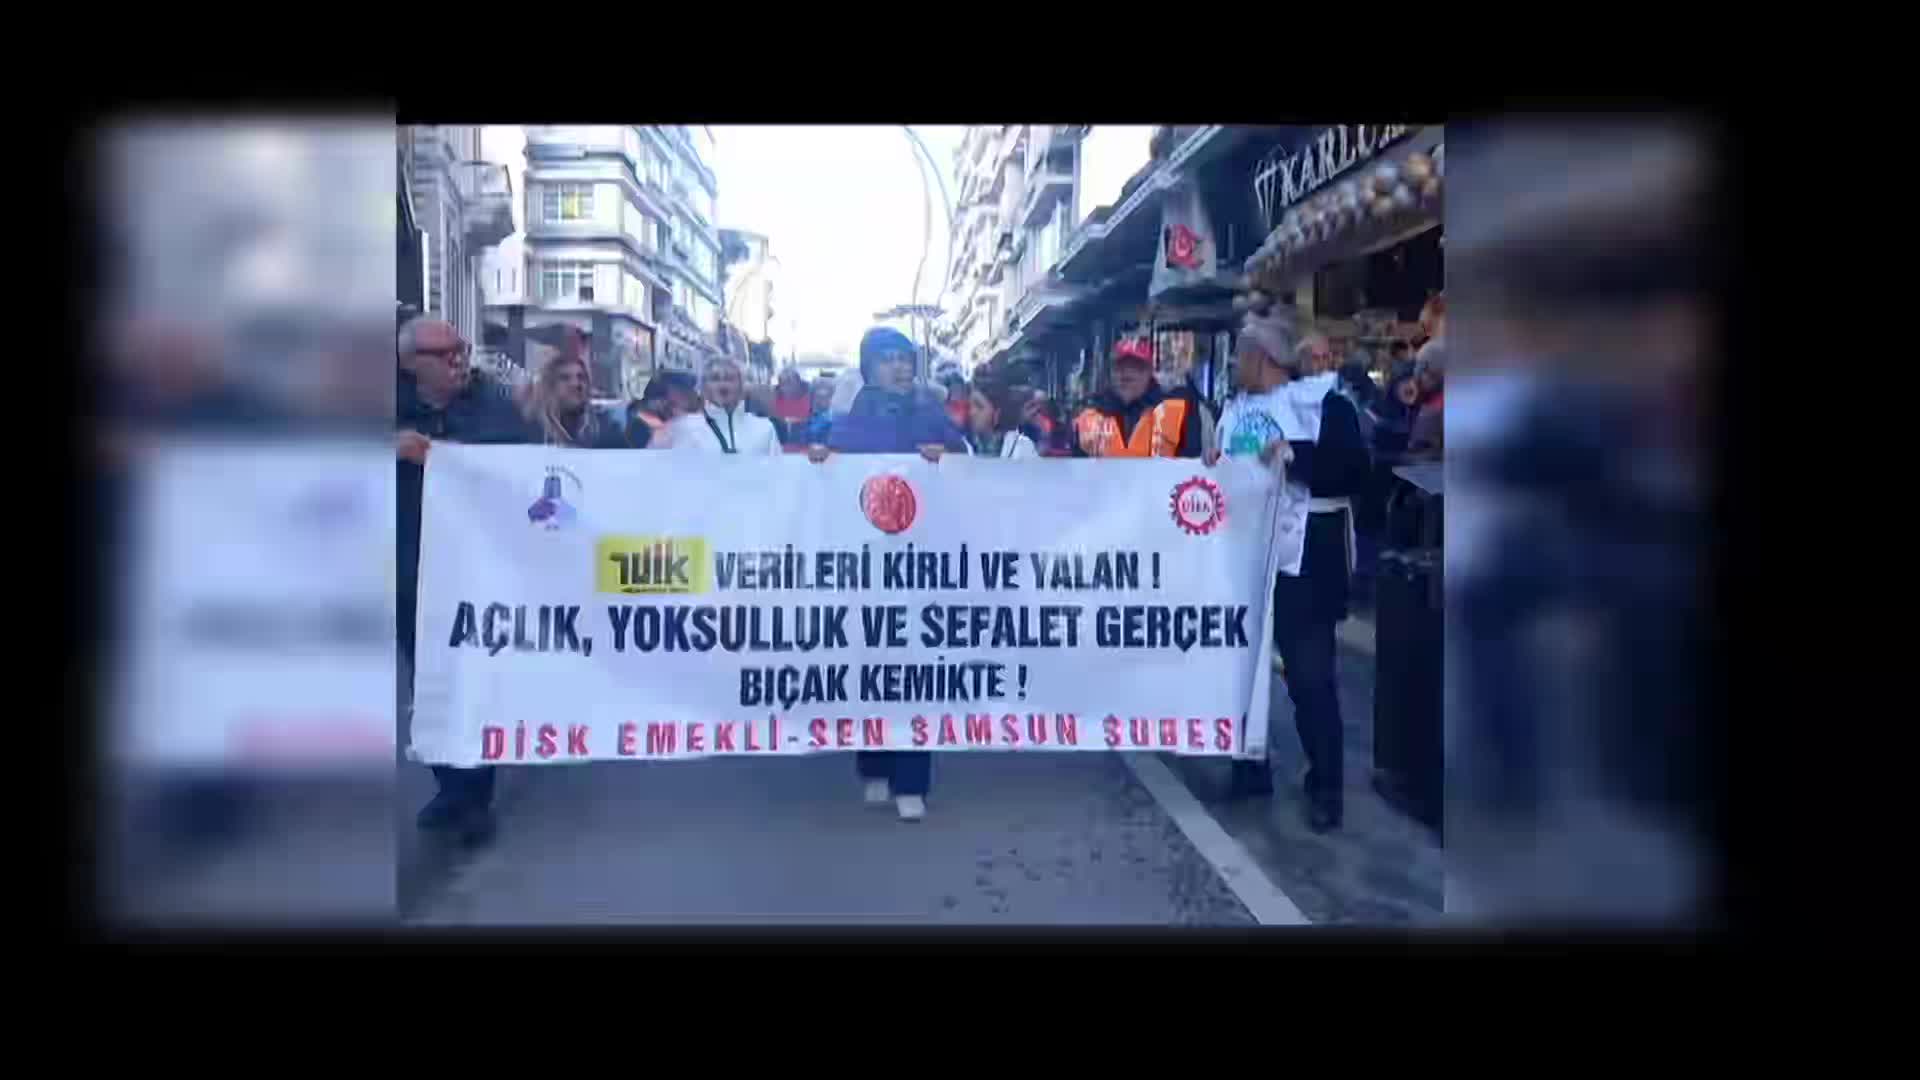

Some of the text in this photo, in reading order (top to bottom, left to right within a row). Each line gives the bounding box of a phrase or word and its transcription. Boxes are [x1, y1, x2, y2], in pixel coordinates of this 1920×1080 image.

[716, 543, 872, 590] VERİLERİ
[883, 542, 969, 590] KİRLİ
[980, 551, 1020, 590] VE
[1030, 551, 1139, 590] YALAN
[1151, 551, 1161, 589] !
[448, 600, 1249, 657] AÇLIK, YOKSULLUK VE SEFALET GERÇEK
[738, 655, 1028, 710] BIÇAK KEMİKTE !
[481, 719, 593, 761] DİSK
[617, 714, 888, 757] EMEKLİ-SEN
[910, 712, 1078, 748] SAMSUN
